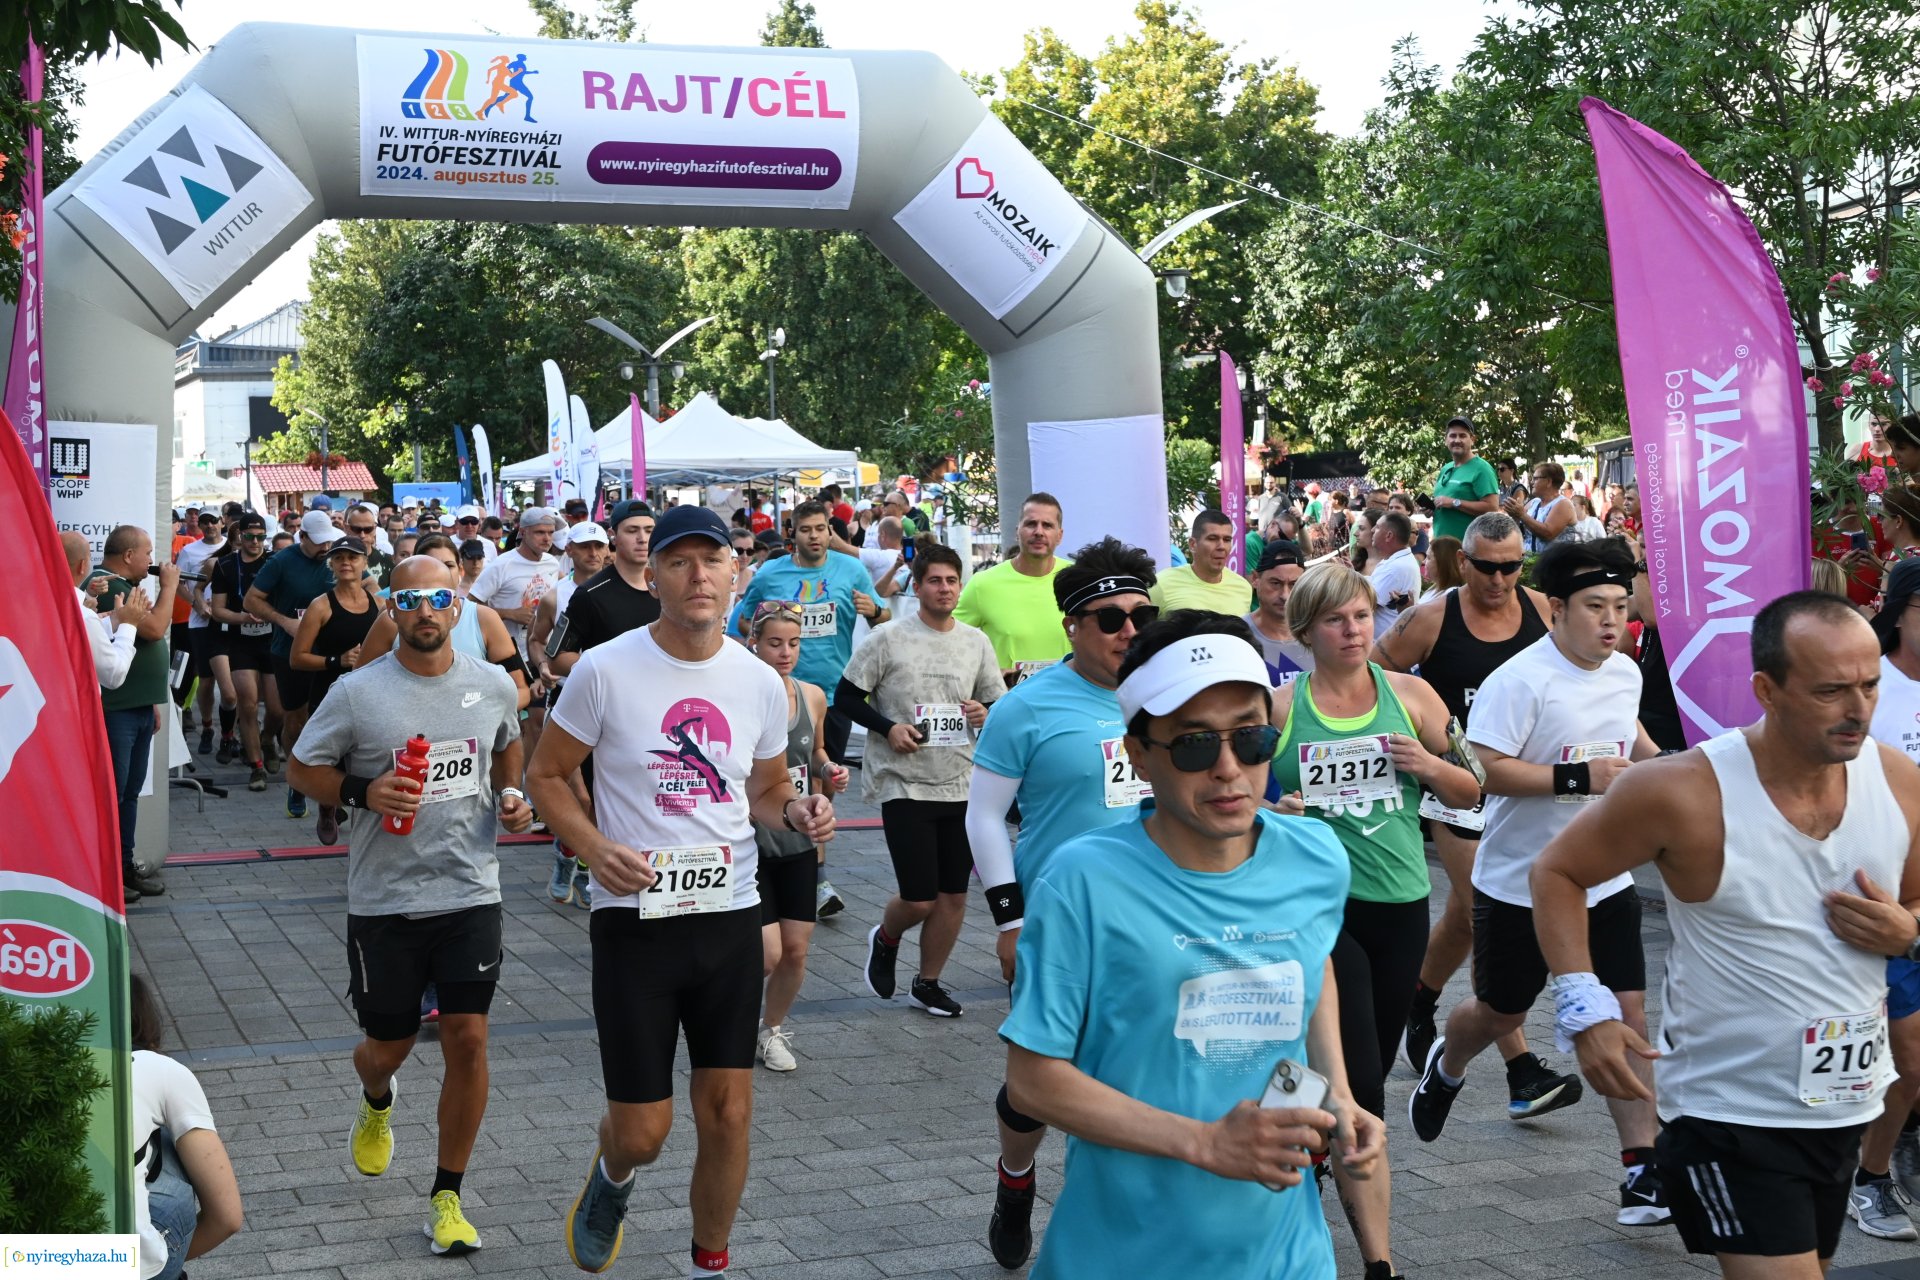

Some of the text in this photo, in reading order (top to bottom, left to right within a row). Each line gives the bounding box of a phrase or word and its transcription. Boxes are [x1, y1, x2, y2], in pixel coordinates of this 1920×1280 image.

[582, 69, 846, 119] RAJT/CÉL
[379, 125, 562, 147] IV. WITTUR-NYÍREGYHÁZI
[376, 138, 562, 169] FUTÓFESZTIVÁL
[376, 165, 560, 186] 2024. augusztus 25.
[600, 157, 829, 177] www.nyiregyhazifutofesztival.hu
[203, 201, 264, 257] WITTUR
[987, 191, 1055, 257] MOZAIK
[1024, 244, 1045, 265] med
[50, 479, 90, 489] SCOPE
[57, 490, 83, 499] WHP
[803, 613, 833, 627] 1130
[425, 757, 473, 783] 208
[1309, 757, 1387, 786] 21312
[666, 779, 685, 792] CÉL
[686, 779, 704, 787] FELÉ!
[648, 867, 727, 893] 21052
